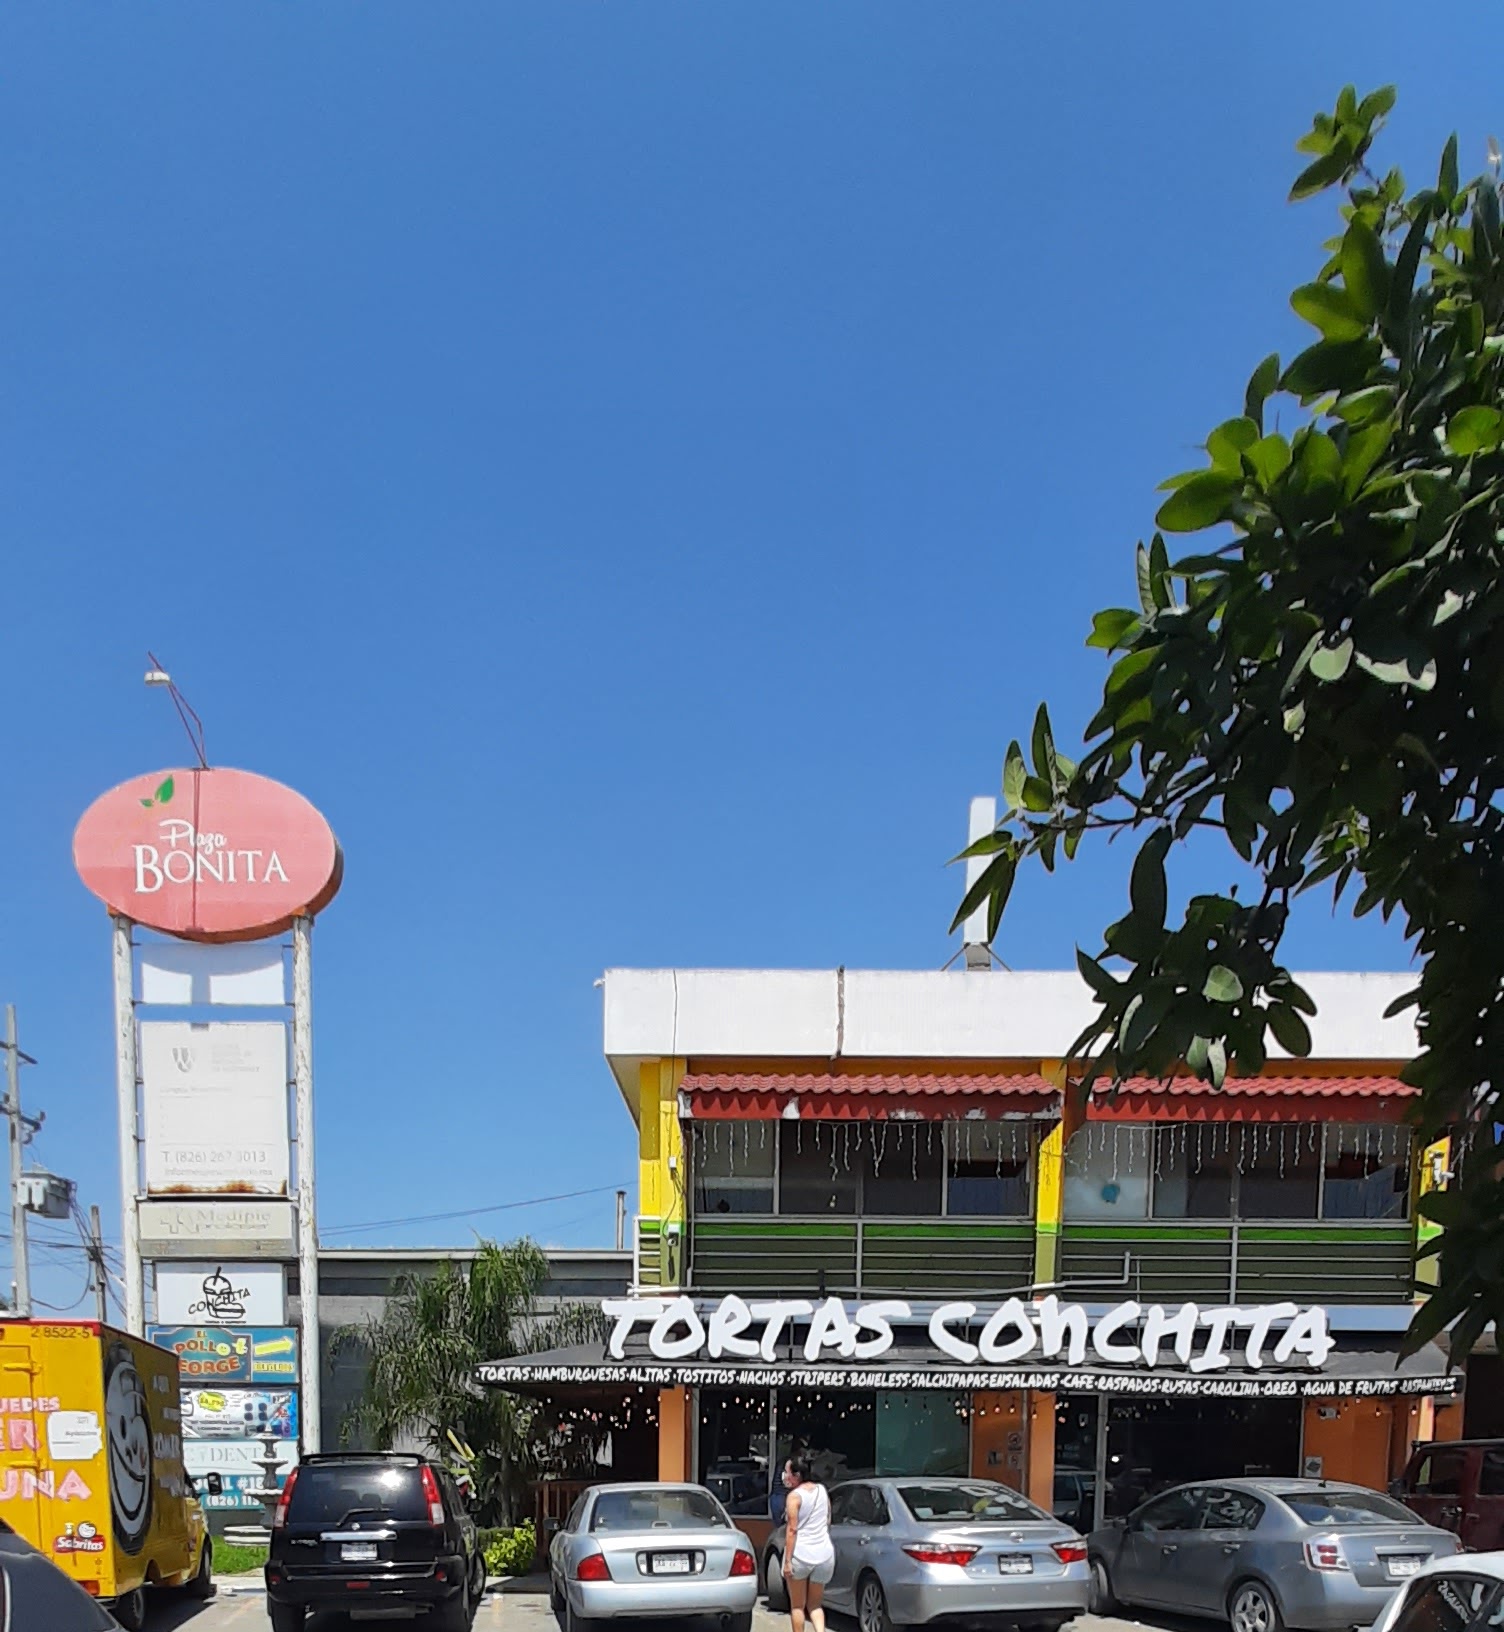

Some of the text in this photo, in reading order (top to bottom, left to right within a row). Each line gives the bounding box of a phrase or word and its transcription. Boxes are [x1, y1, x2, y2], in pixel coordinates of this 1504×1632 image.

[159, 818, 228, 854] Plaza
[132, 844, 290, 893] BONITA
[601, 1294, 912, 1362] TORTAS
[178, 1356, 241, 1375] EORGE
[478, 1366, 531, 1382] TORTAS
[533, 1366, 627, 1382] HAMBURGUESAS
[629, 1367, 672, 1383] ALITAS
[676, 1368, 736, 1385] TOSTITOS
[739, 1370, 786, 1385] NACHOS
[790, 1371, 846, 1386] STRIPERS
[850, 1371, 908, 1387] BONELESS
[912, 1372, 989, 1388] SALCHIPAPAS
[989, 1373, 1060, 1388] ENSALADAS
[1062, 1373, 1094, 1389] CAFE
[1099, 1375, 1160, 1393] RASPADOS
[1161, 1379, 1200, 1394] RUSAS
[1202, 1380, 1259, 1396] CAROLINA
[1263, 1380, 1297, 1395] OREO
[1303, 1380, 1335, 1395] AGUA
[1337, 1381, 1352, 1395] DE
[1355, 1380, 1399, 1395] FRUTAS
[57, 1536, 104, 1551] Sabritas
